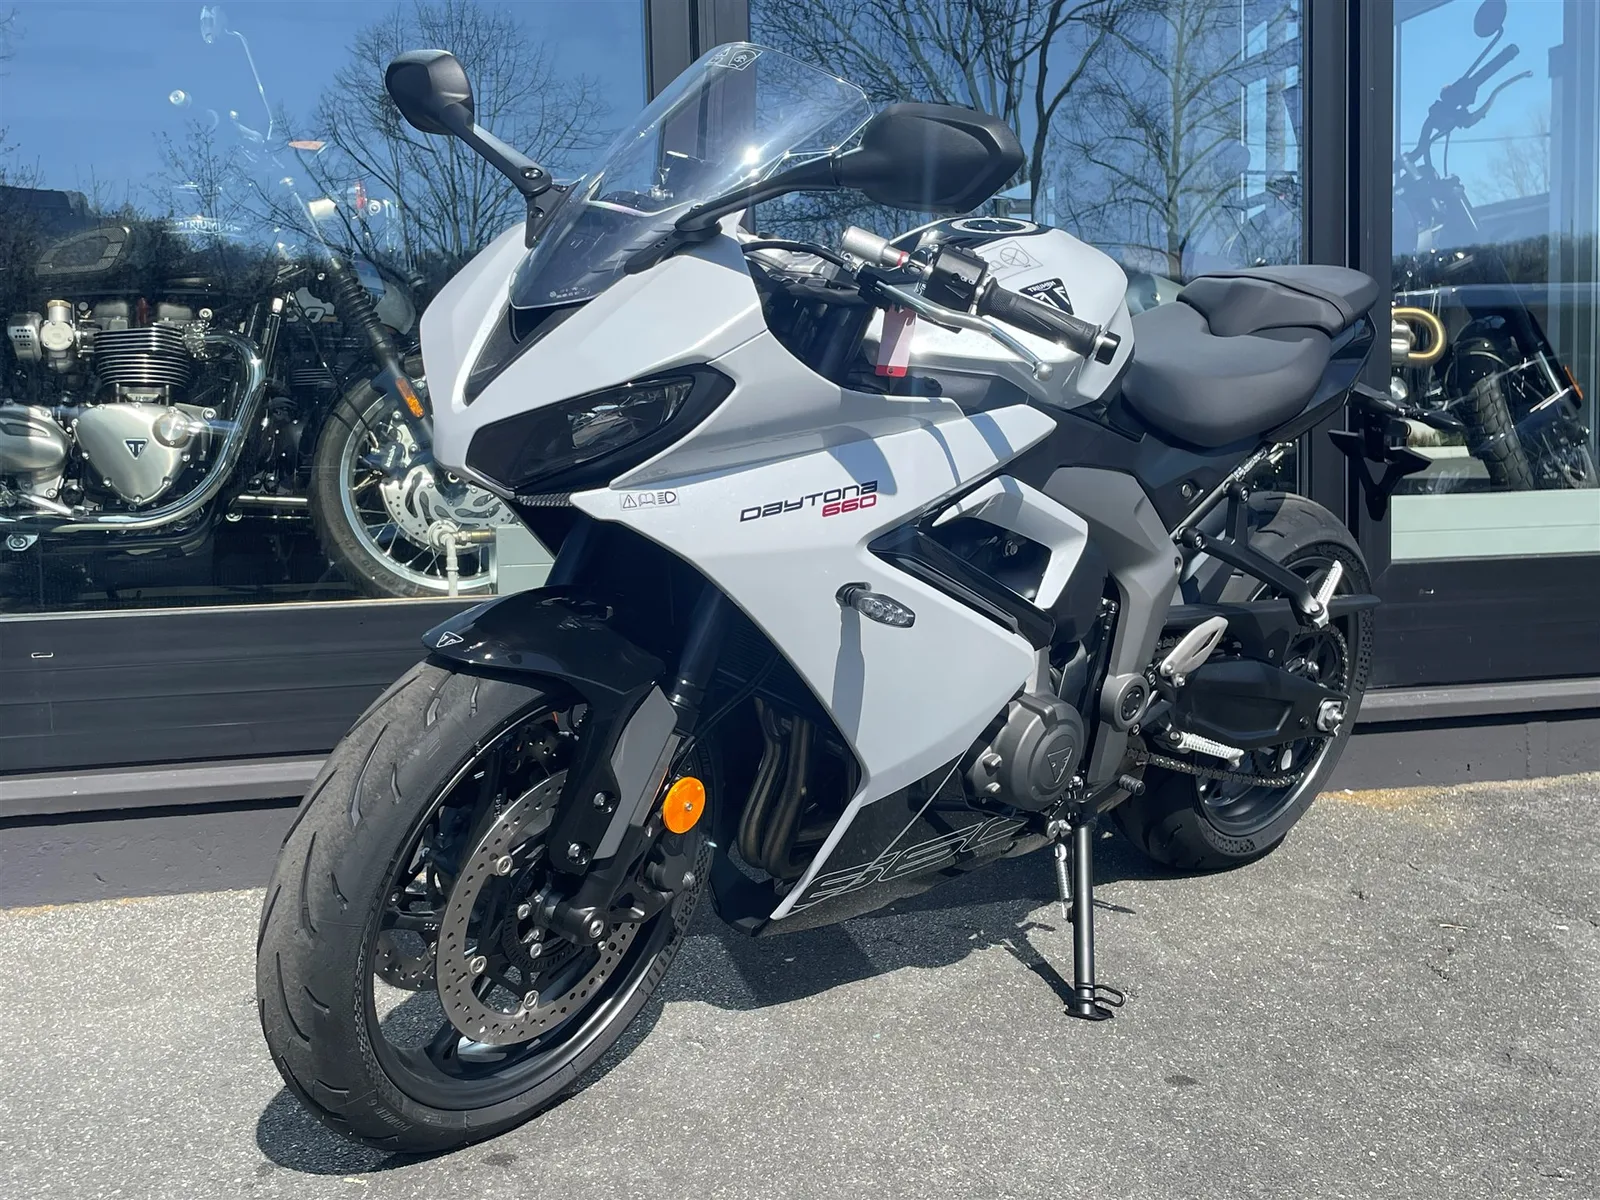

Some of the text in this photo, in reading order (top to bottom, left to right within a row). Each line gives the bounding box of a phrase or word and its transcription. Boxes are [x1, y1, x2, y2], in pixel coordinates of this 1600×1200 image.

[1028, 281, 1056, 292] TRIUMPH
[822, 494, 877, 518] 660
[374, 1106, 413, 1132] POWER
